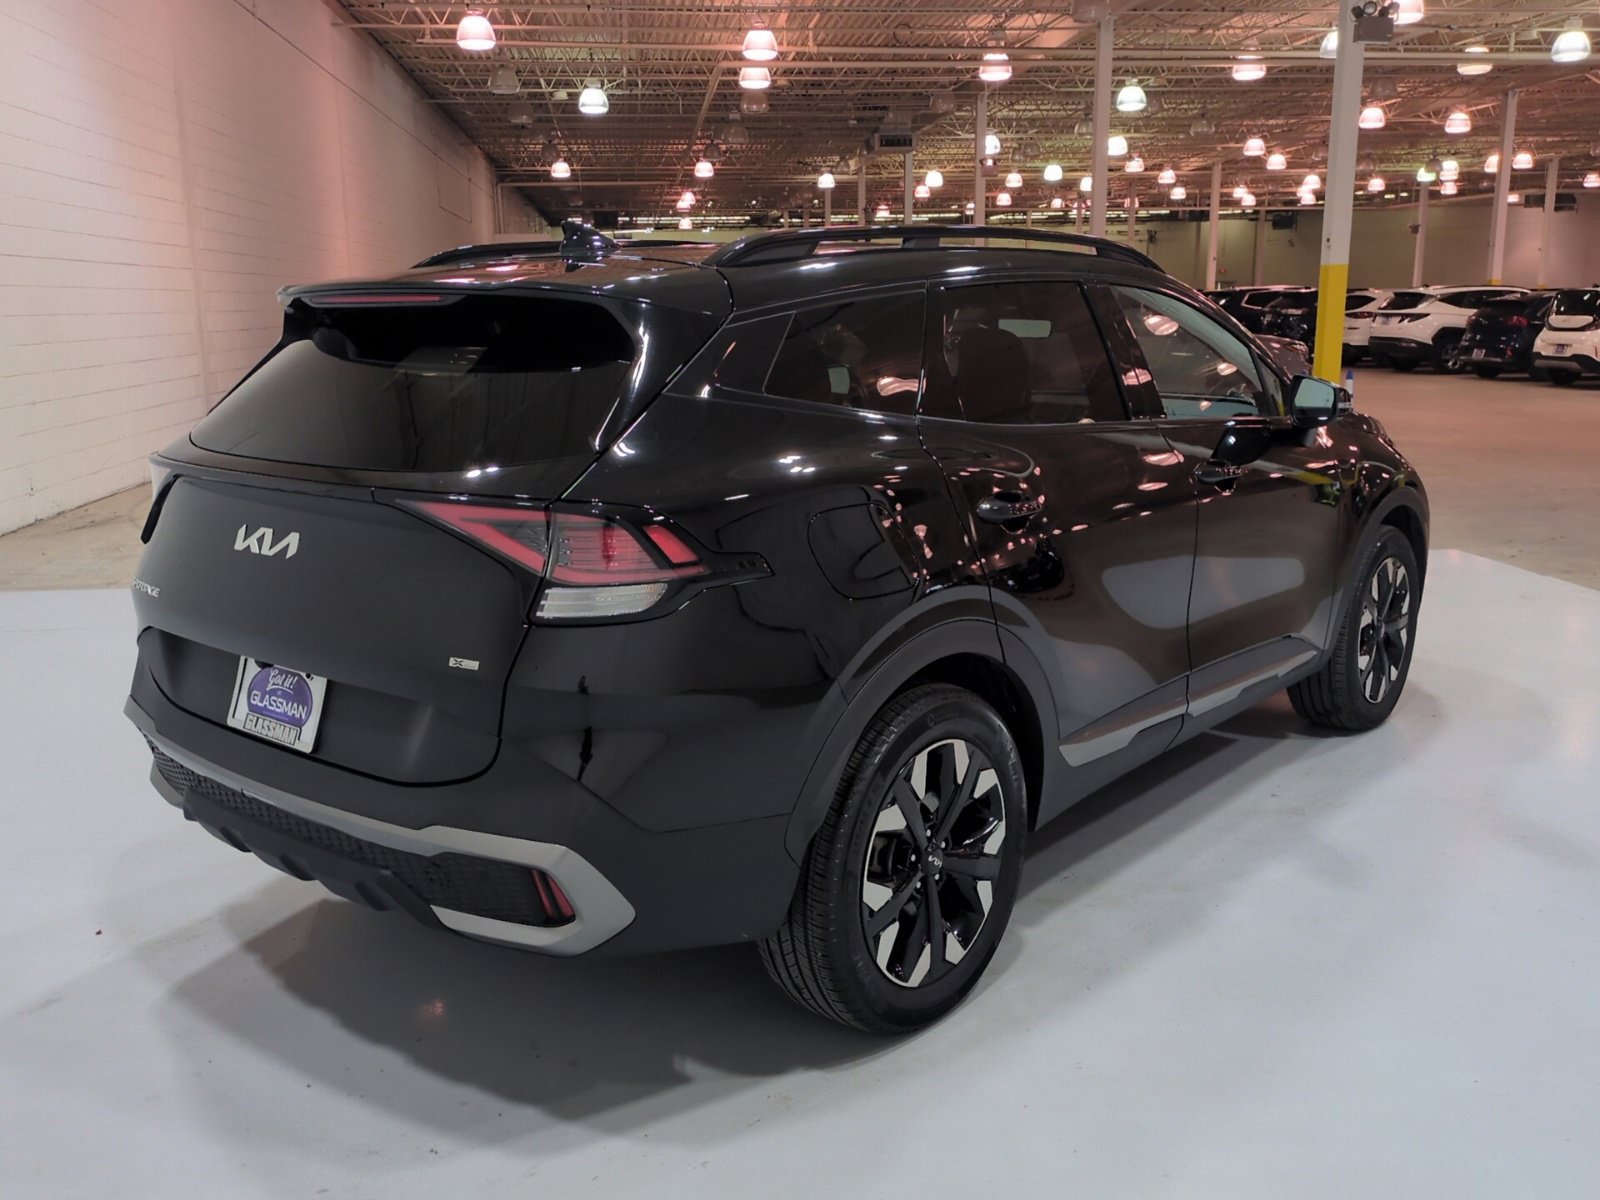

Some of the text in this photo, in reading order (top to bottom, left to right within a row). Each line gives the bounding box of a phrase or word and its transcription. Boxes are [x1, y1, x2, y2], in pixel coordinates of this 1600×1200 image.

[234, 523, 300, 560] KIA
[267, 669, 298, 689] Got it!
[250, 690, 308, 720] GLASSMAN
[245, 715, 298, 745] GLASSMAN
